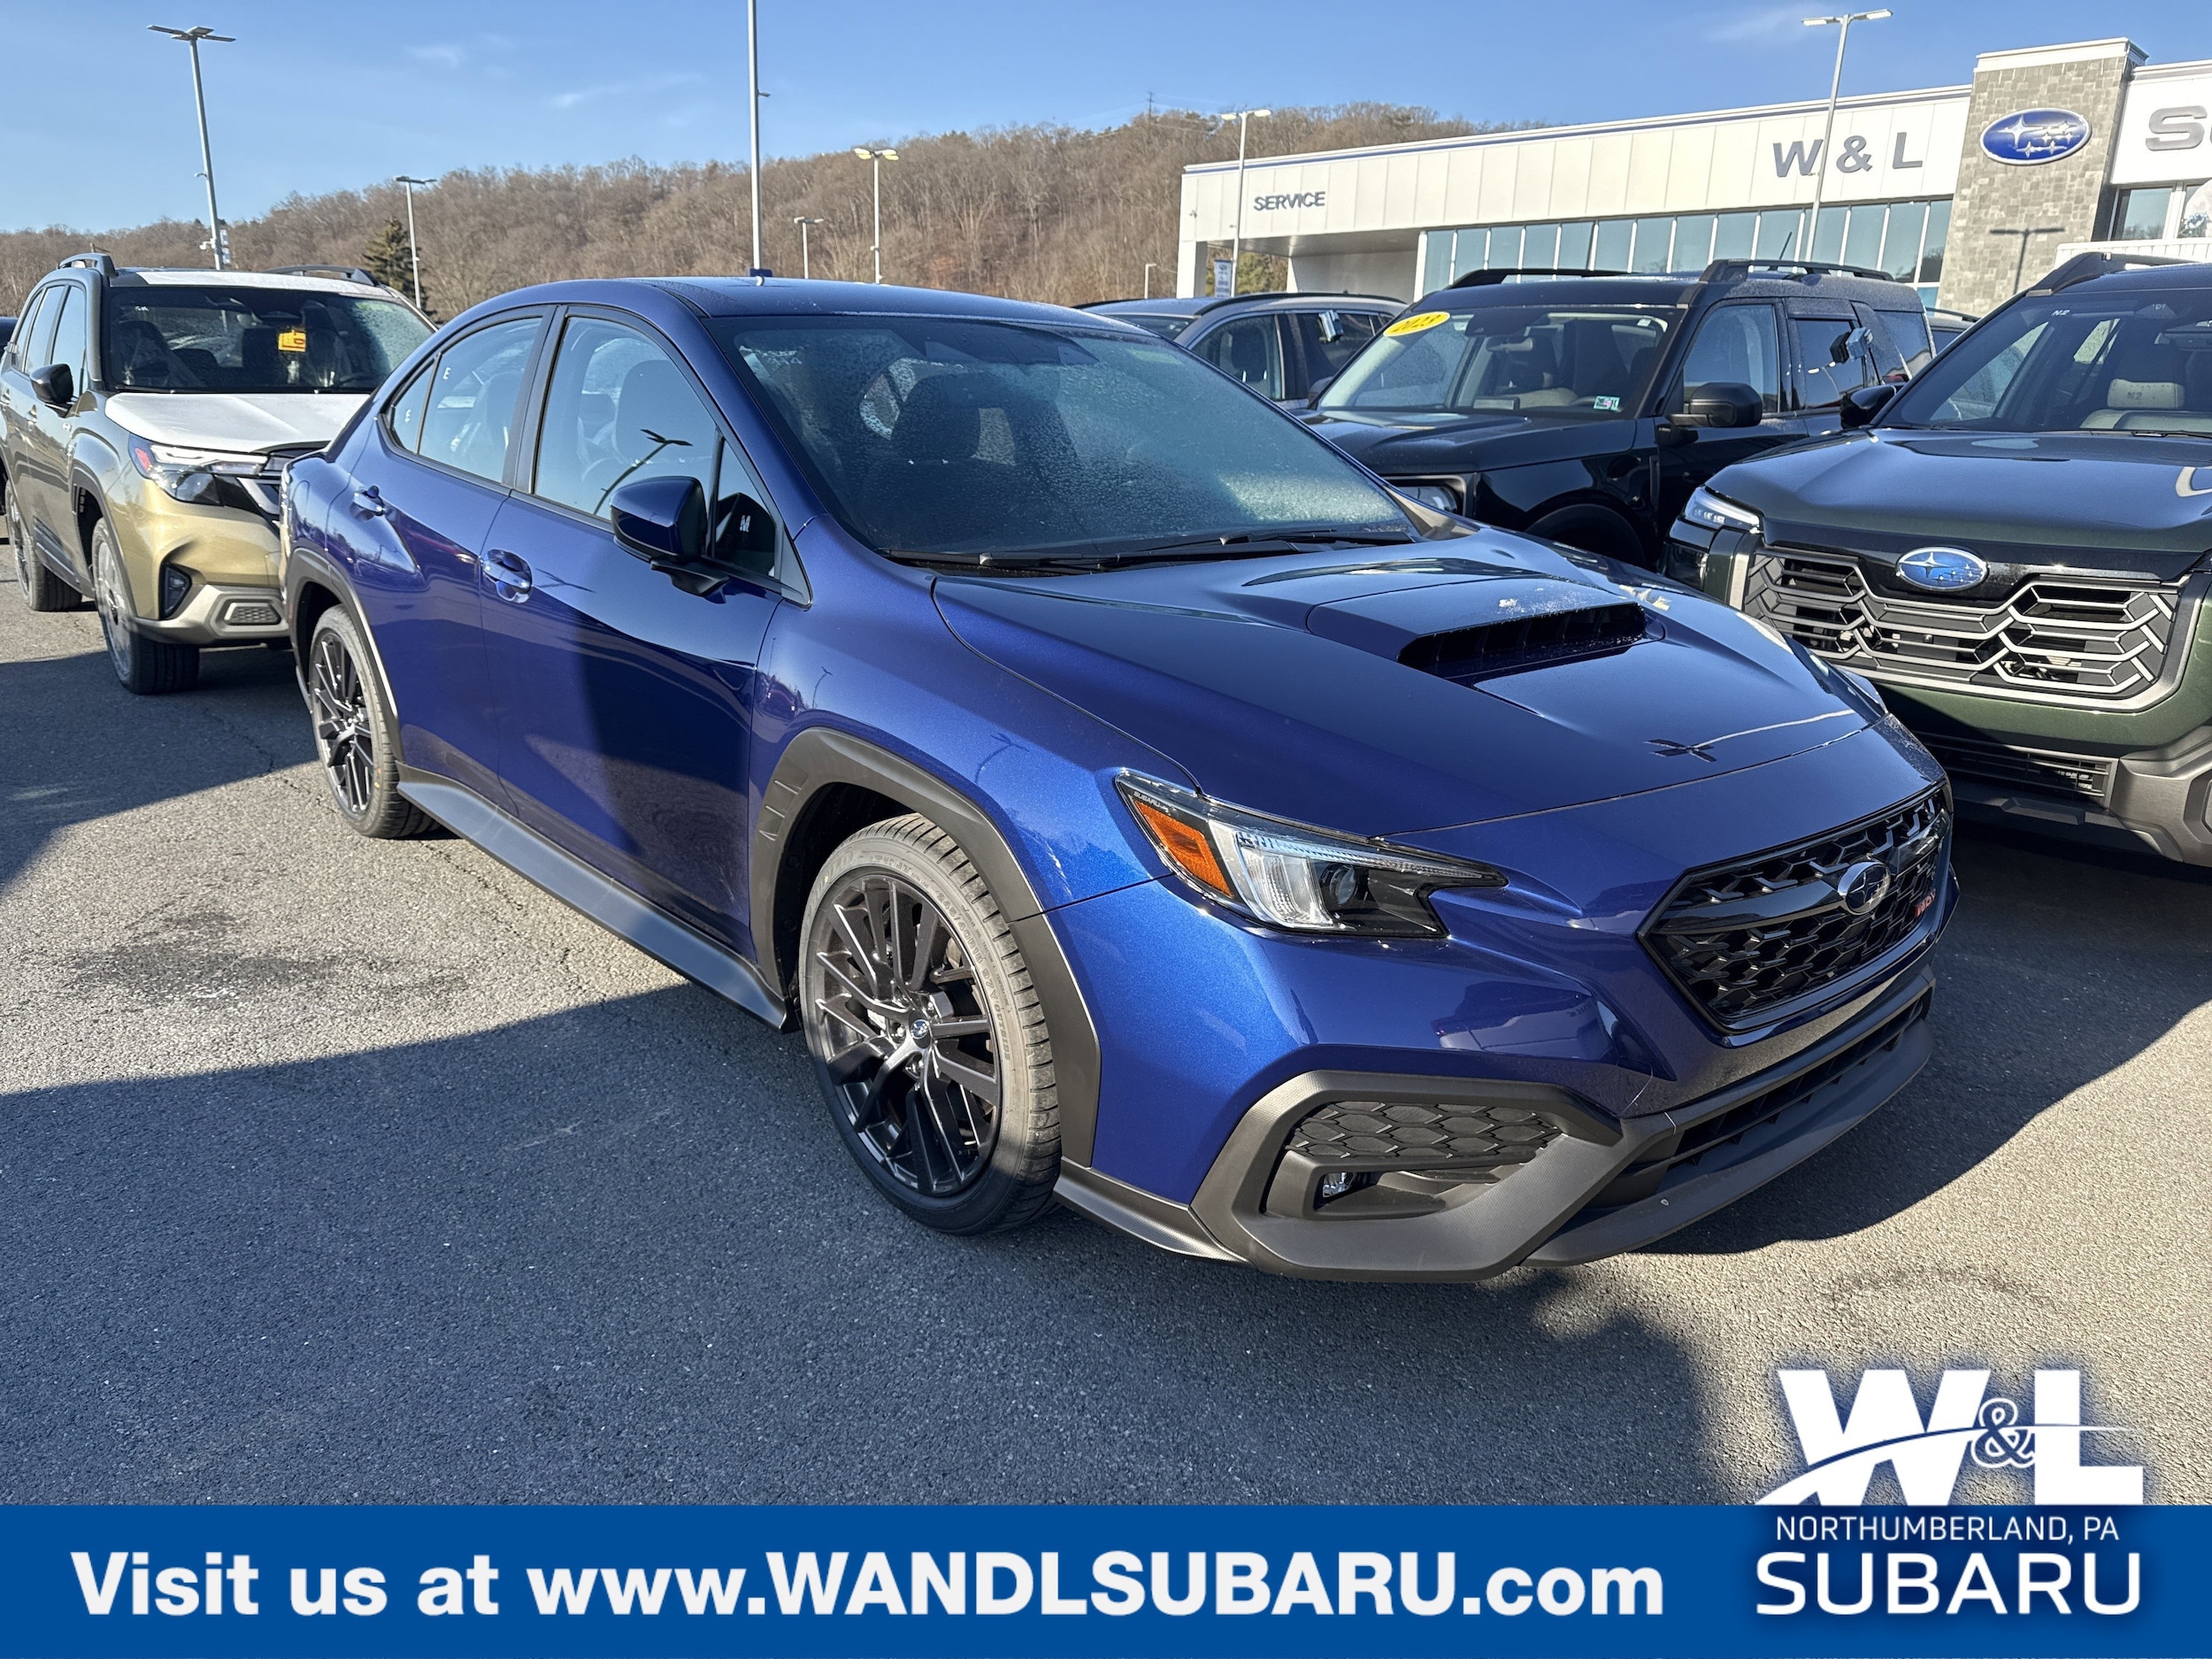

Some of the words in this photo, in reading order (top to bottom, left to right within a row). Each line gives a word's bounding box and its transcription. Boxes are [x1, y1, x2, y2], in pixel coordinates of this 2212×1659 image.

[2145, 105, 2212, 152] S
[1772, 139, 1824, 178] W
[1836, 135, 1872, 173] &
[1892, 132, 1923, 169] L
[1253, 191, 1325, 211] SERVICE
[1133, 790, 1161, 808] SUBARU
[994, 1003, 1011, 1061] OUTSIDE
